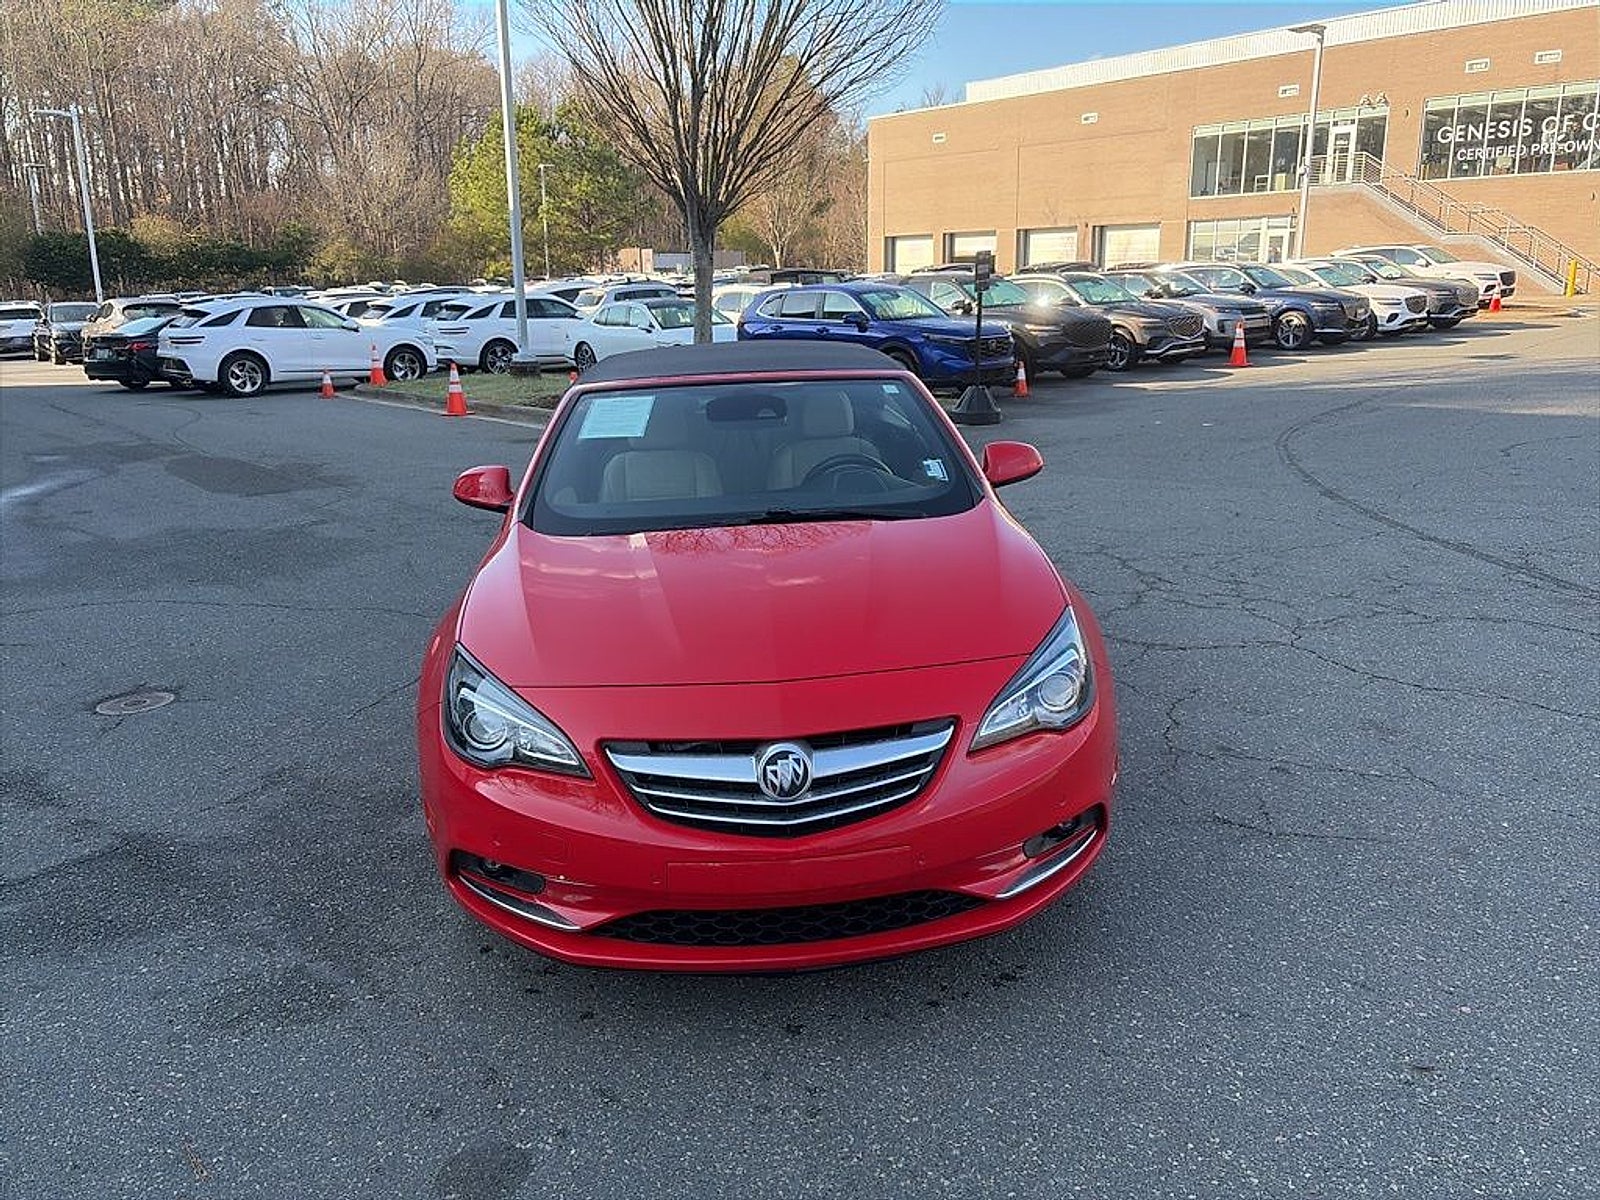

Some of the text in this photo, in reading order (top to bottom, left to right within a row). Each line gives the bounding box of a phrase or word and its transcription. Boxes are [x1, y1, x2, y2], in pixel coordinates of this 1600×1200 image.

[1437, 118, 1533, 144] GENESIS
[1541, 114, 1575, 133] OF
[1456, 145, 1526, 161] CERTIFIED
